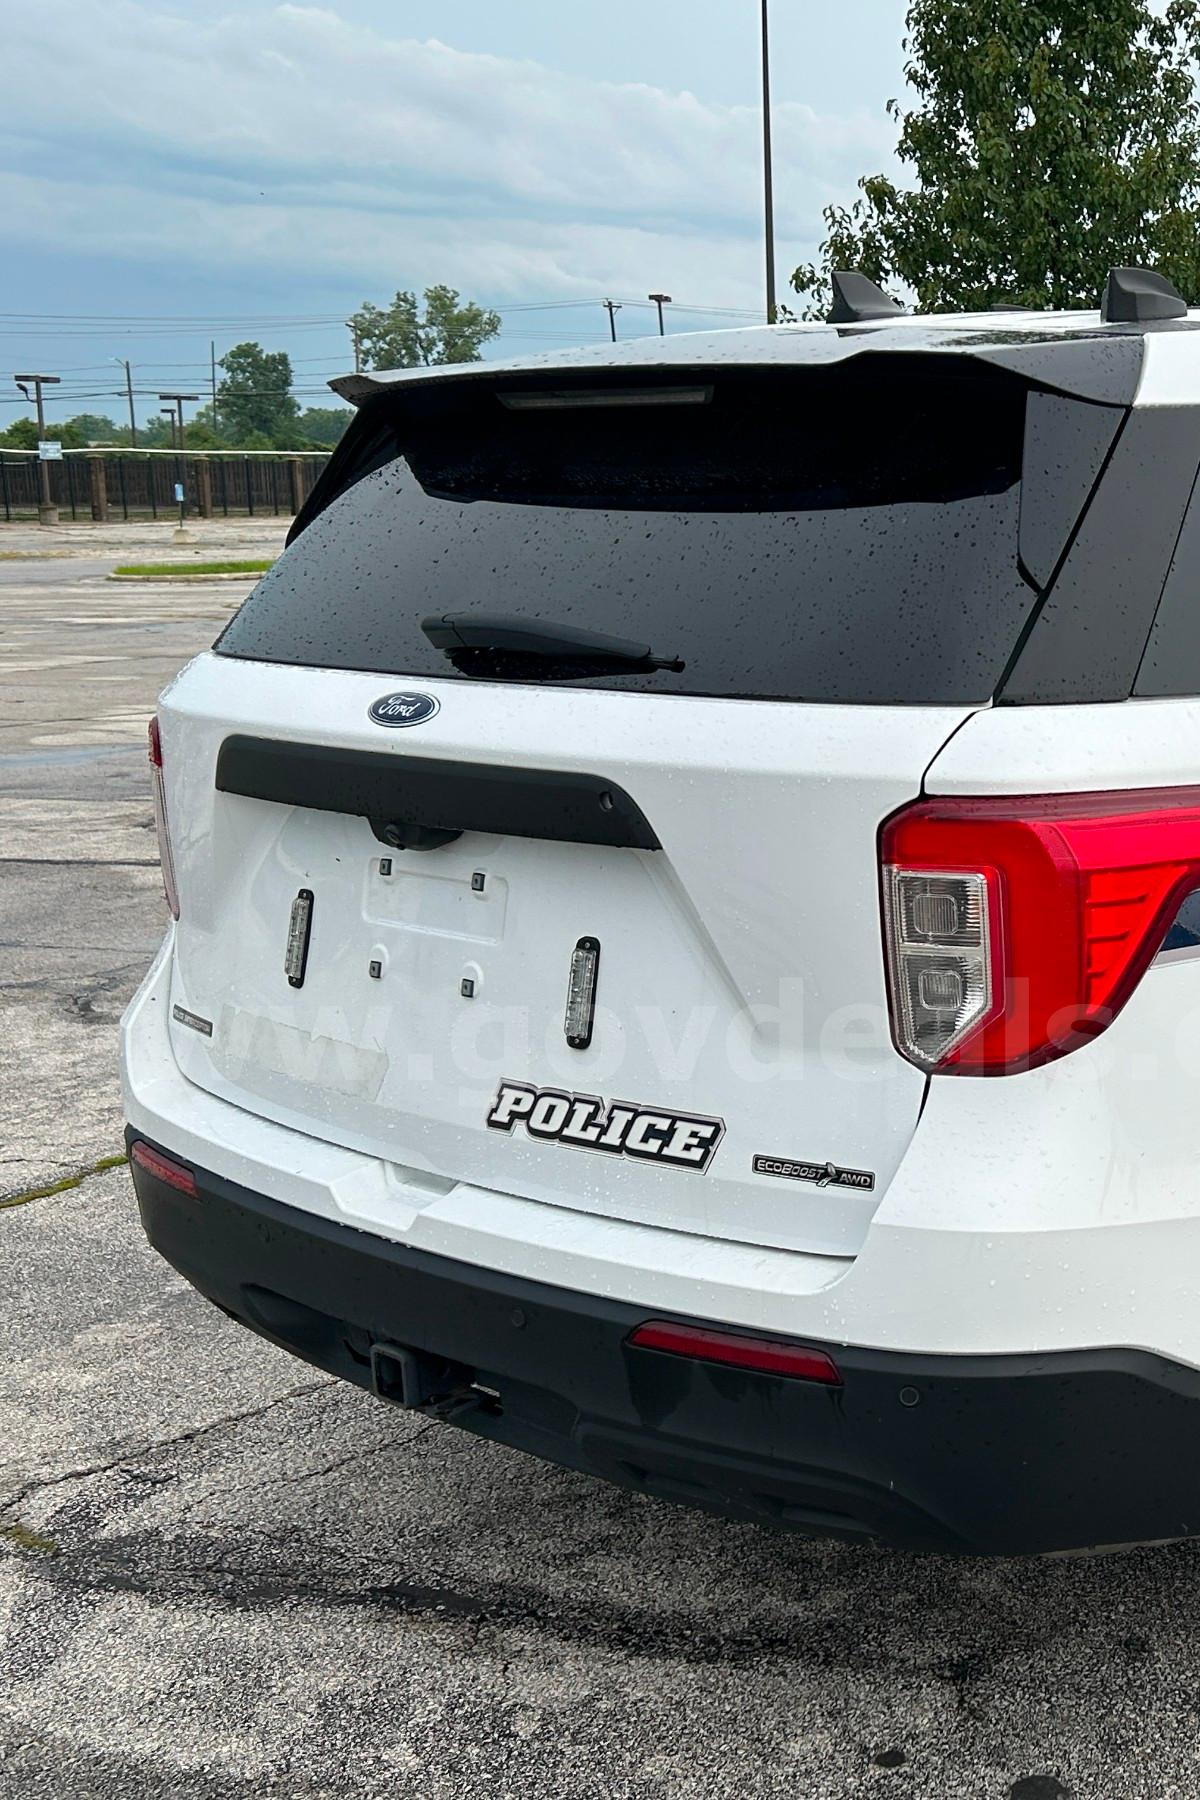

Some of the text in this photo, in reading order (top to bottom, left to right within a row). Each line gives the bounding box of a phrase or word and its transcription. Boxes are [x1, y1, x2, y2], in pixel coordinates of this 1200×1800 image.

[378, 695, 422, 717] Ford
[489, 1086, 716, 1162] POLICE
[756, 1159, 871, 1187] ECOBOOST AWD
